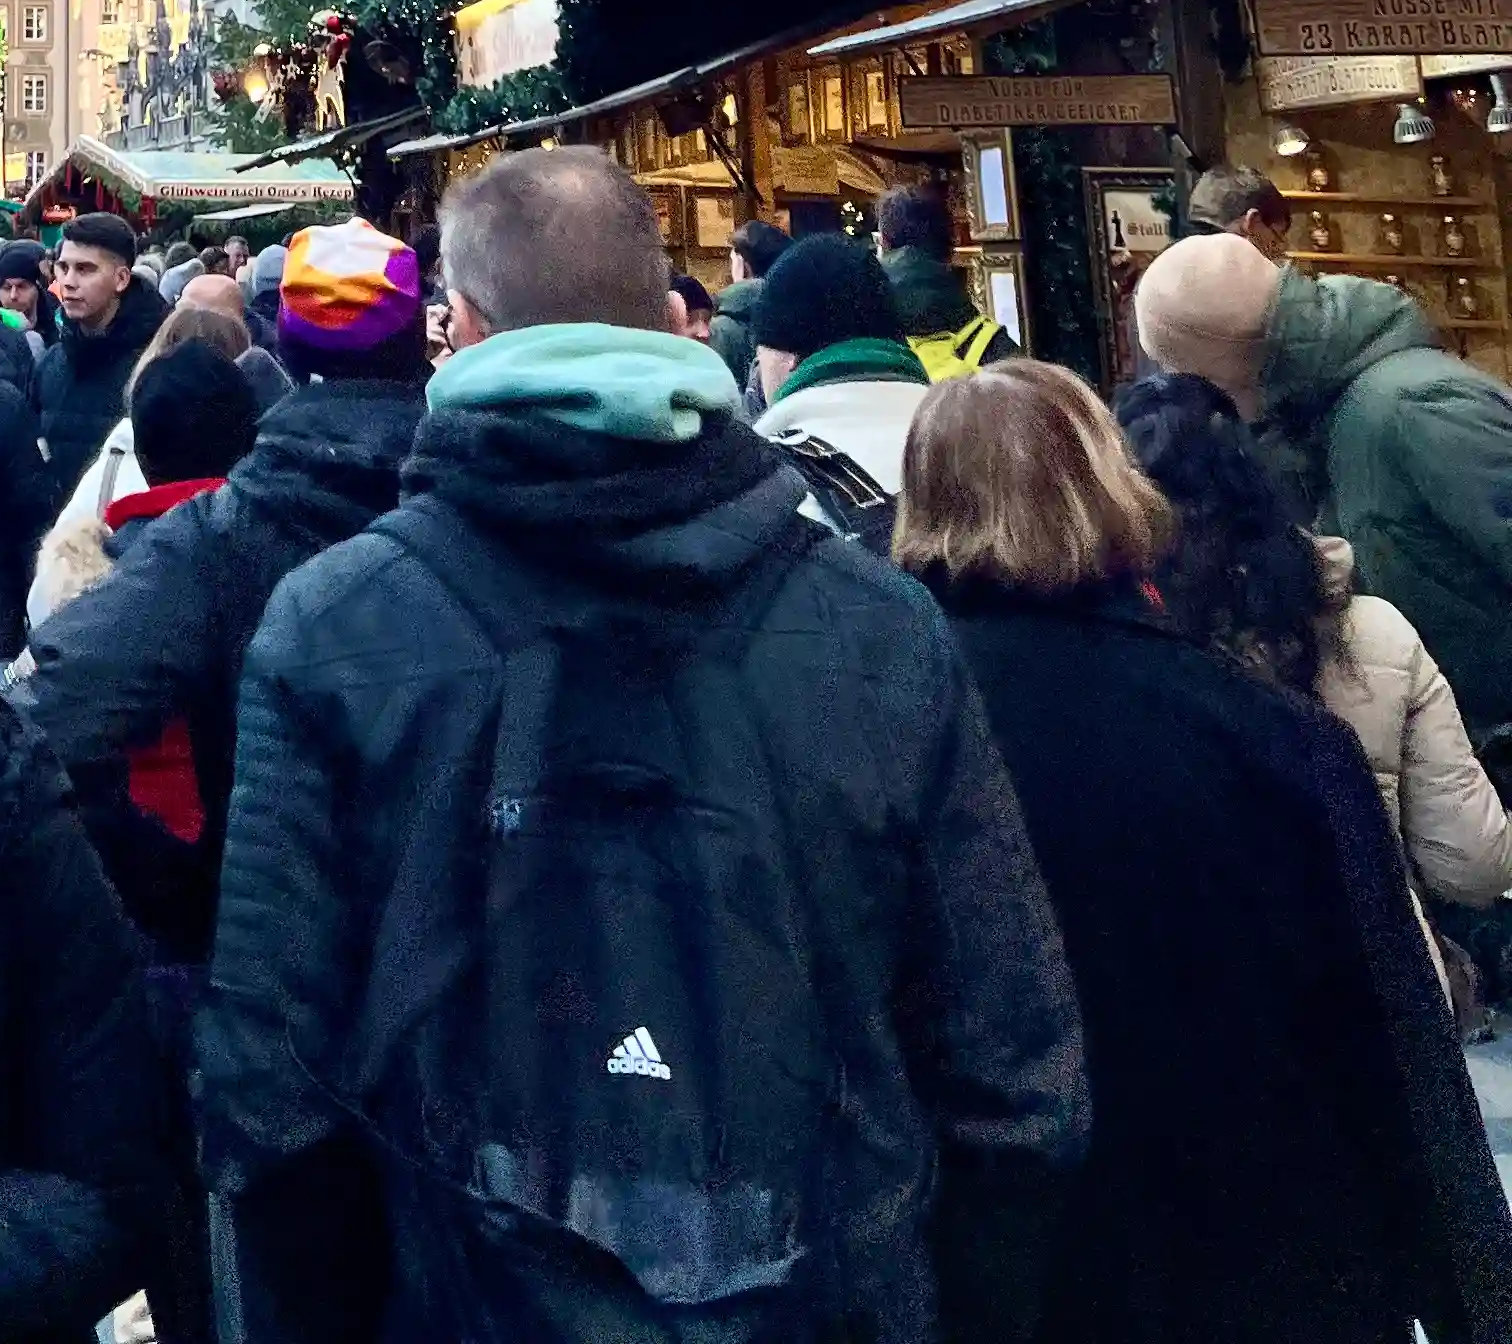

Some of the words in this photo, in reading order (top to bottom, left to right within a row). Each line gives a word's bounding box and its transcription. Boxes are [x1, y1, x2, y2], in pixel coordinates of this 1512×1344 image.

[231, 185, 264, 198] nach
[312, 185, 356, 201] Rezep
[606, 1054, 672, 1081] adidas
